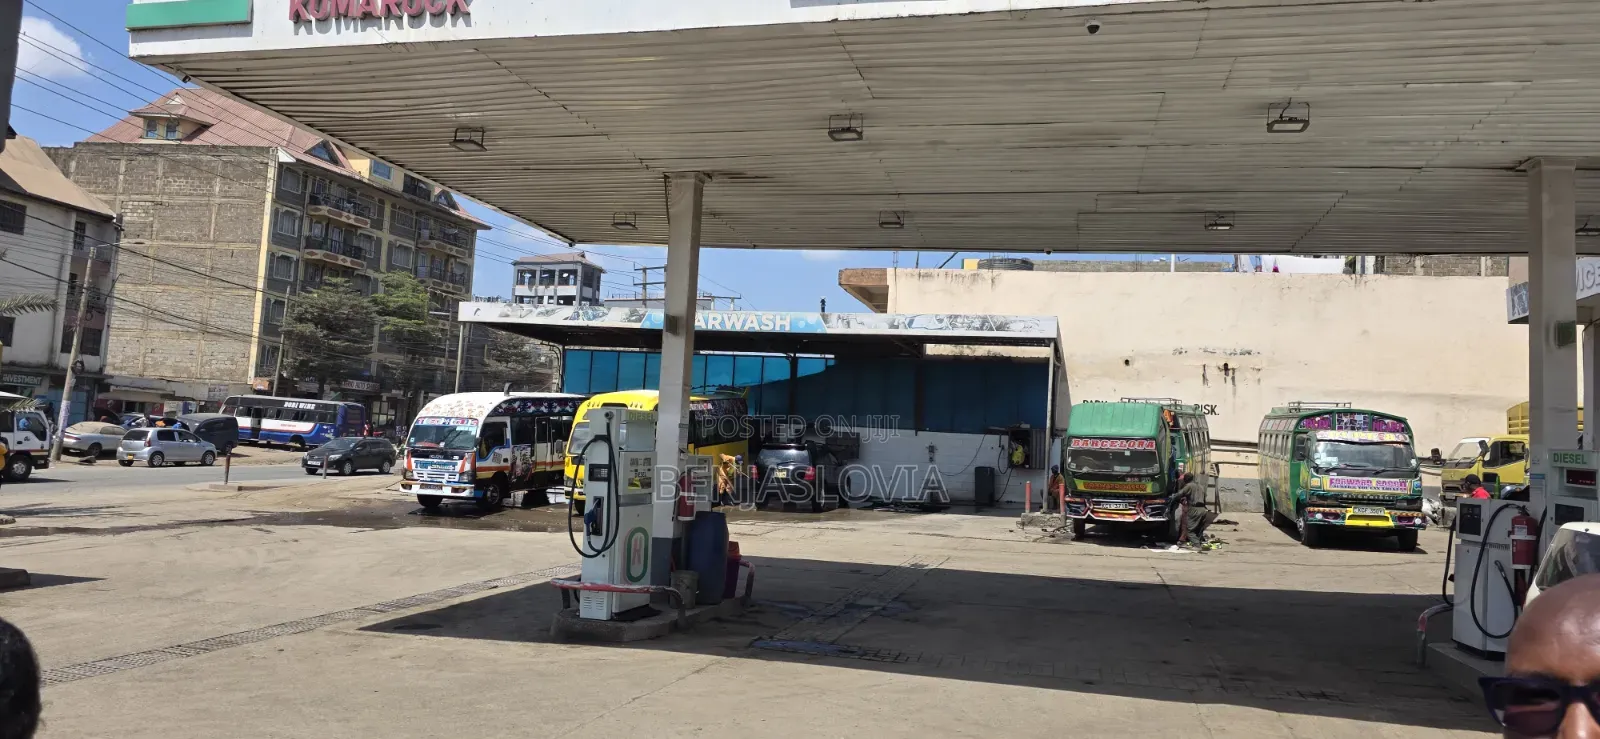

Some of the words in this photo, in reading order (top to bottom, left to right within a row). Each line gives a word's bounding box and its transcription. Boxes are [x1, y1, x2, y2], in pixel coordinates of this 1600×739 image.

[696, 312, 791, 332] ARWASH
[1071, 438, 1156, 449] BARCELONA
[1553, 453, 1587, 464] DIESEL
[1329, 477, 1373, 487] FORWARD
